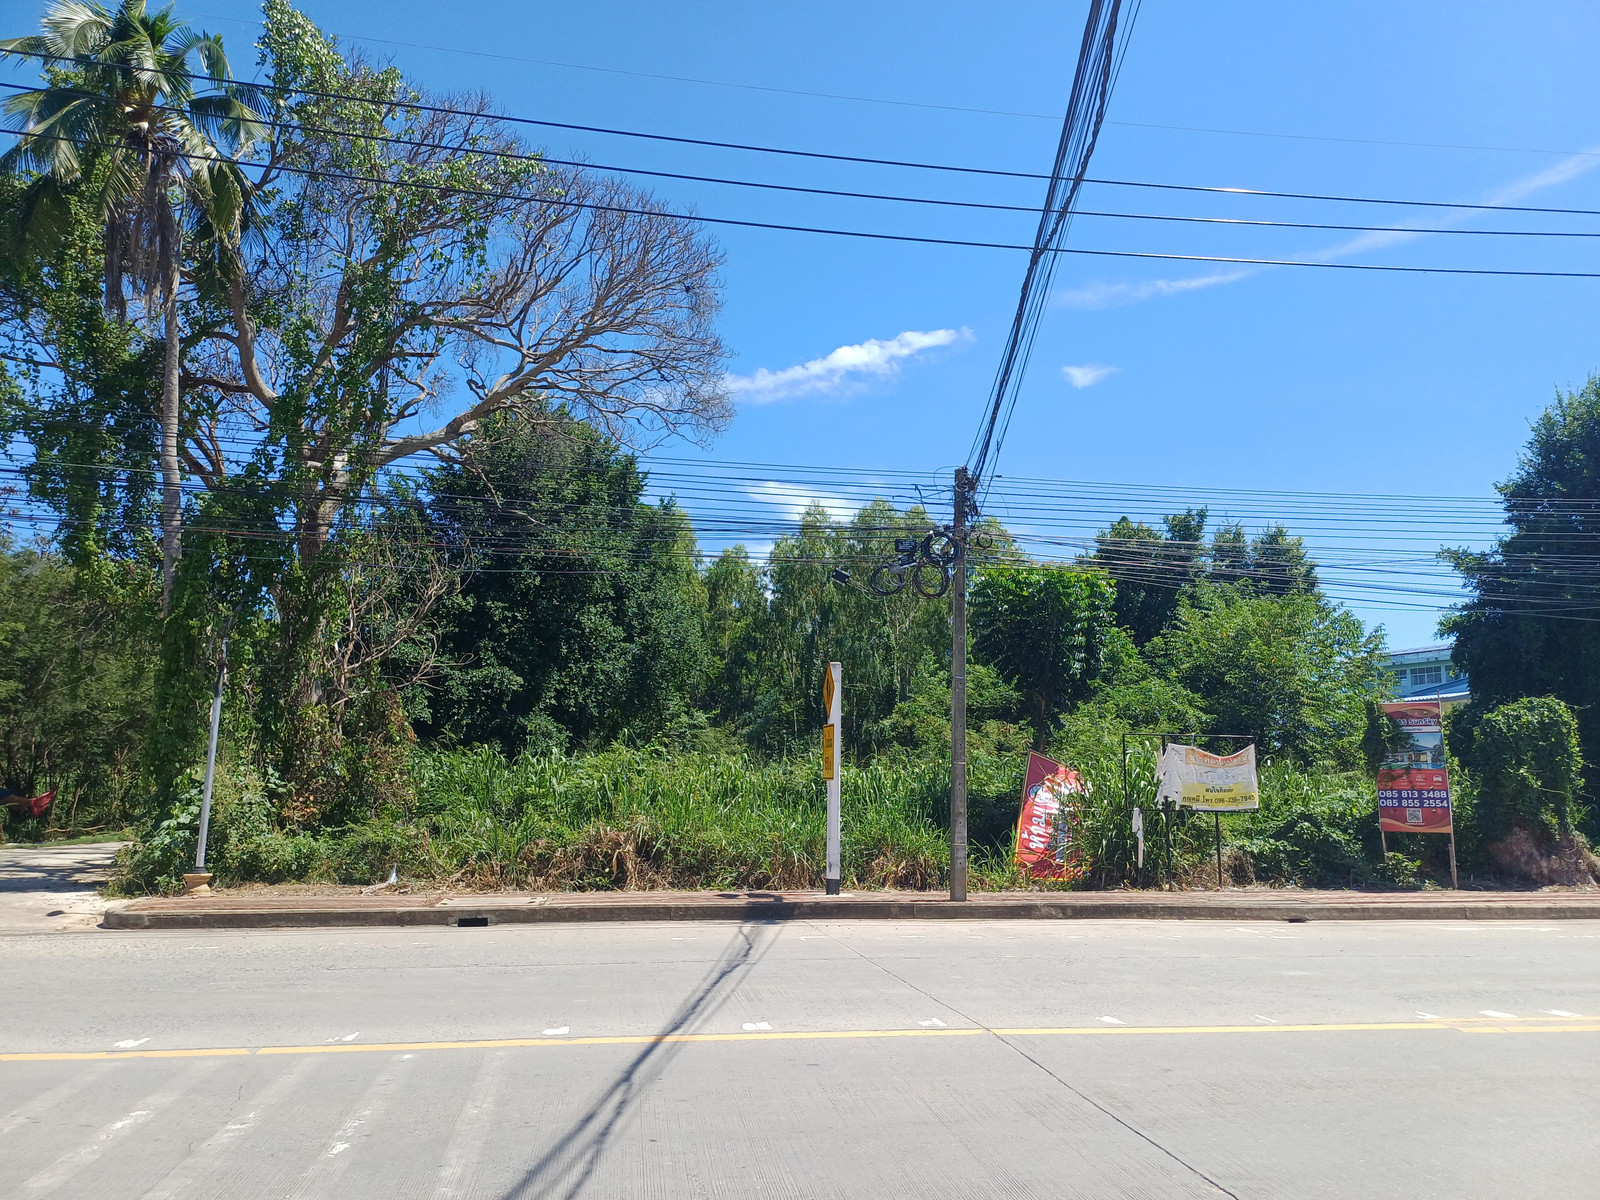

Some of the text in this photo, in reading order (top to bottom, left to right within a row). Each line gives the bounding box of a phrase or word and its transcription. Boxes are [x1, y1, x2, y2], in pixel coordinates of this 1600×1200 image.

[1408, 717, 1437, 726] SunSky
[1379, 790, 1447, 798] 085 813 3488
[1379, 799, 1448, 807] 085 855 2554
